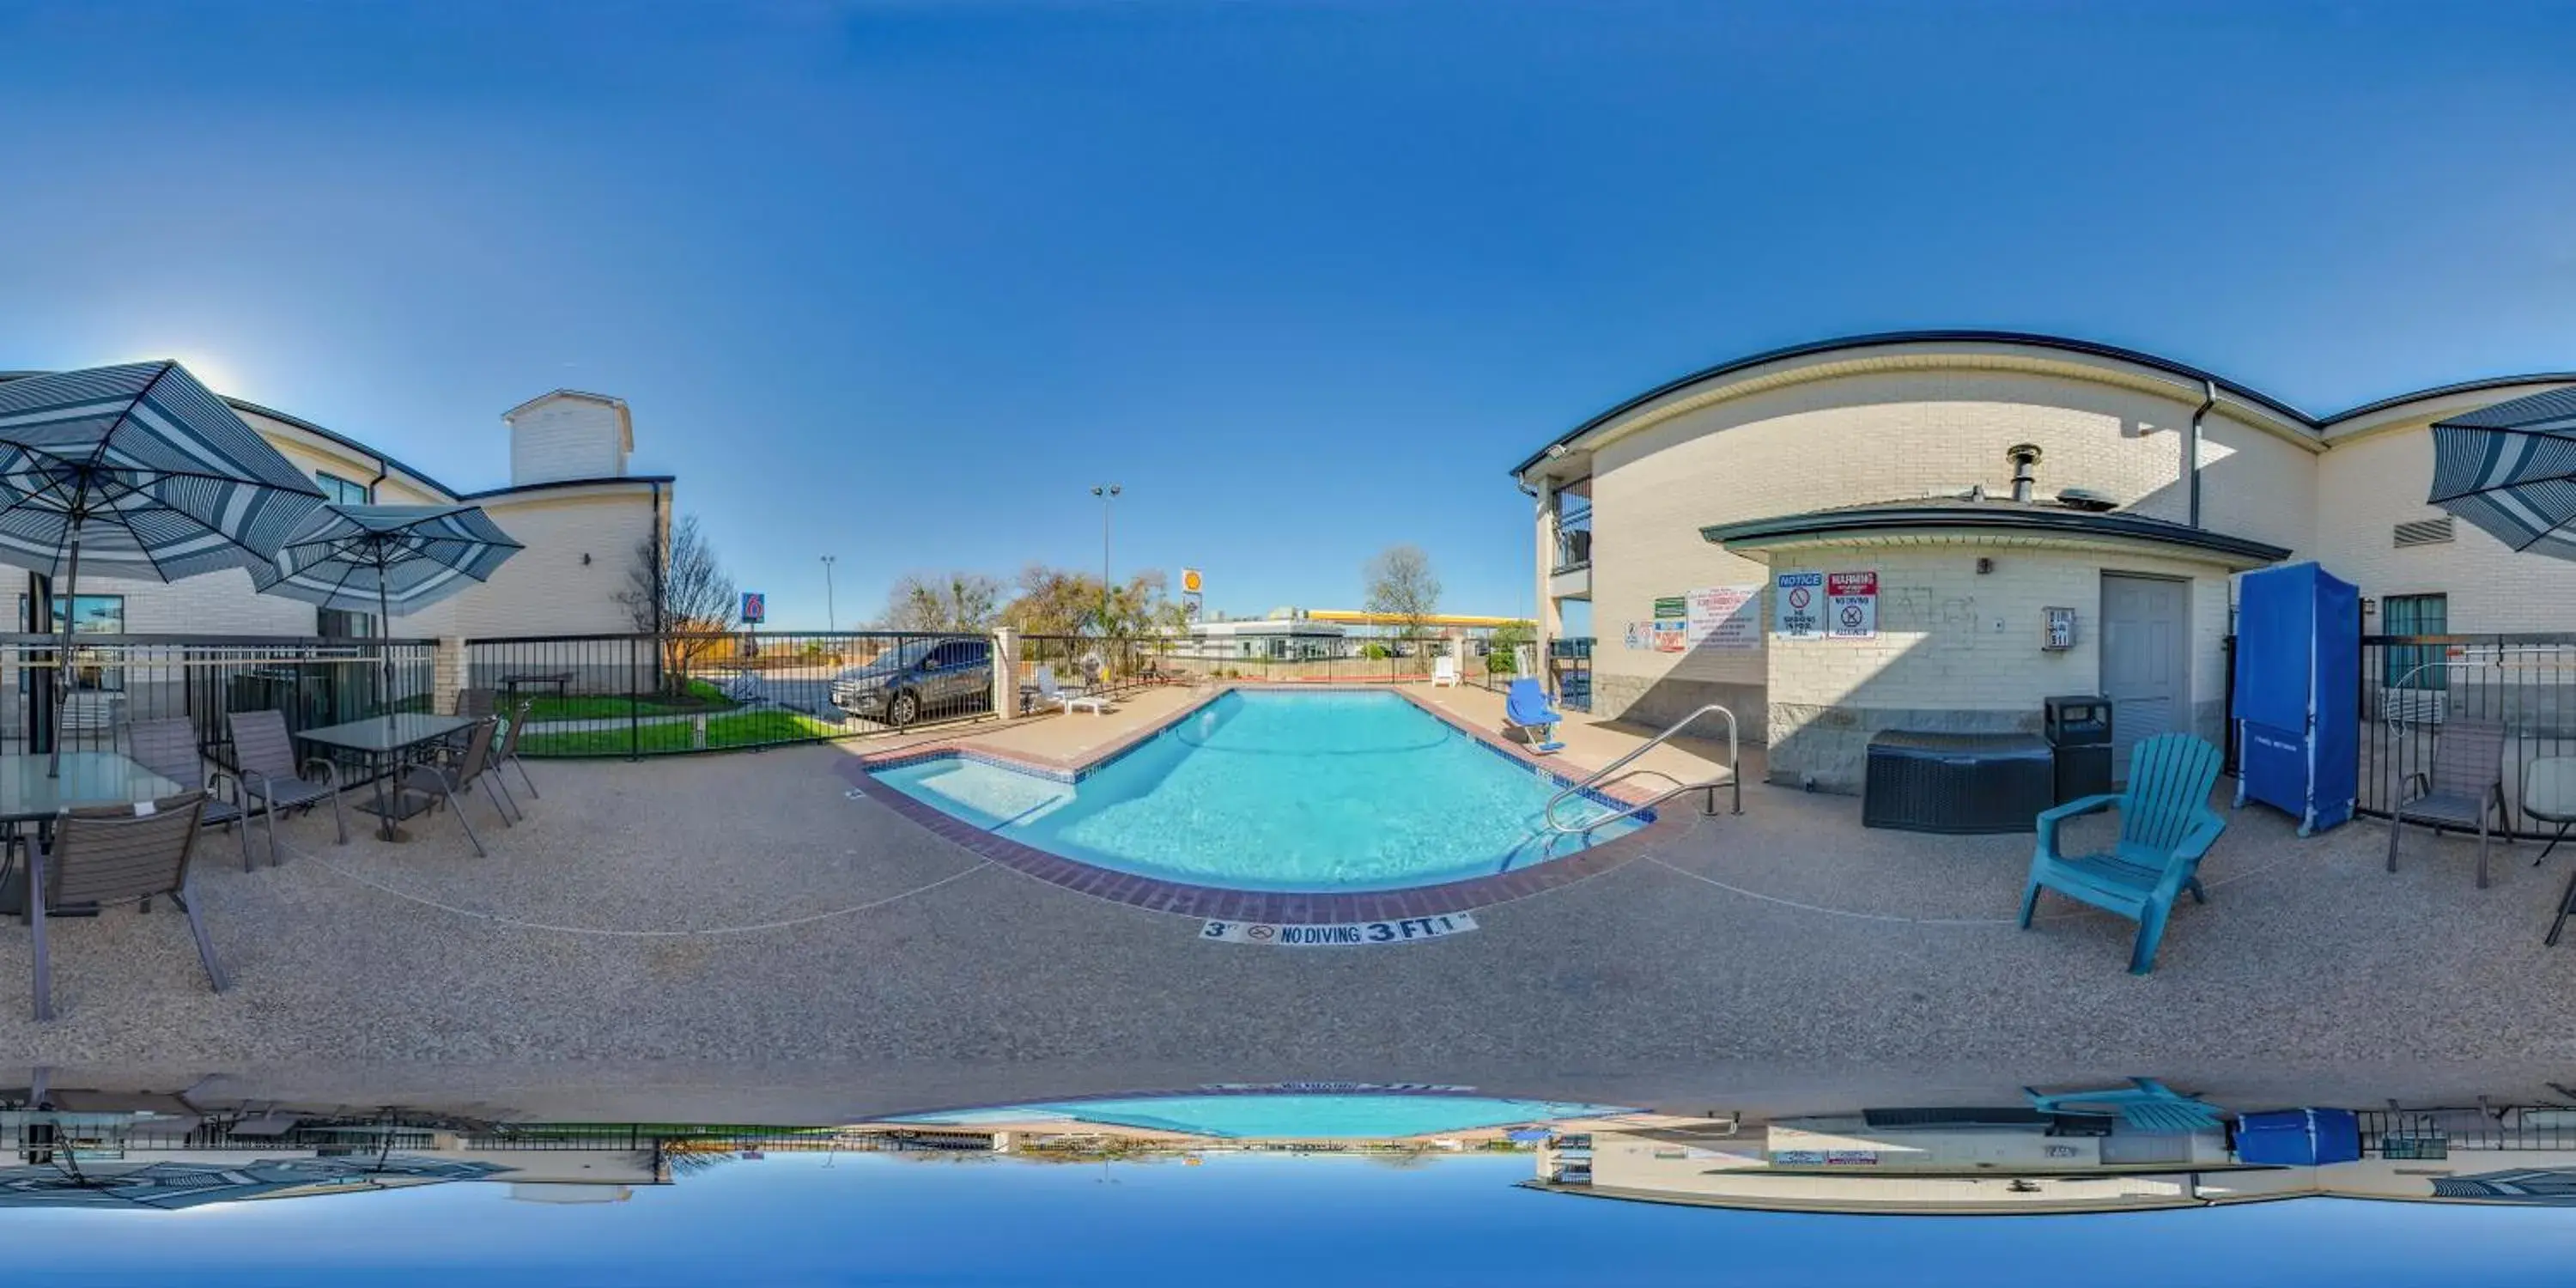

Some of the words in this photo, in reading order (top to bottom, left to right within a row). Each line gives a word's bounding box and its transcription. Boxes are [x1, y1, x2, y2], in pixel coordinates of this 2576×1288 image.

[1780, 574, 1820, 586] NOTICE
[745, 594, 763, 618] 6
[1205, 921, 1226, 937] 3
[1280, 927, 1301, 944] NO
[1304, 927, 1360, 944] DIVING
[1367, 923, 1395, 941] 3
